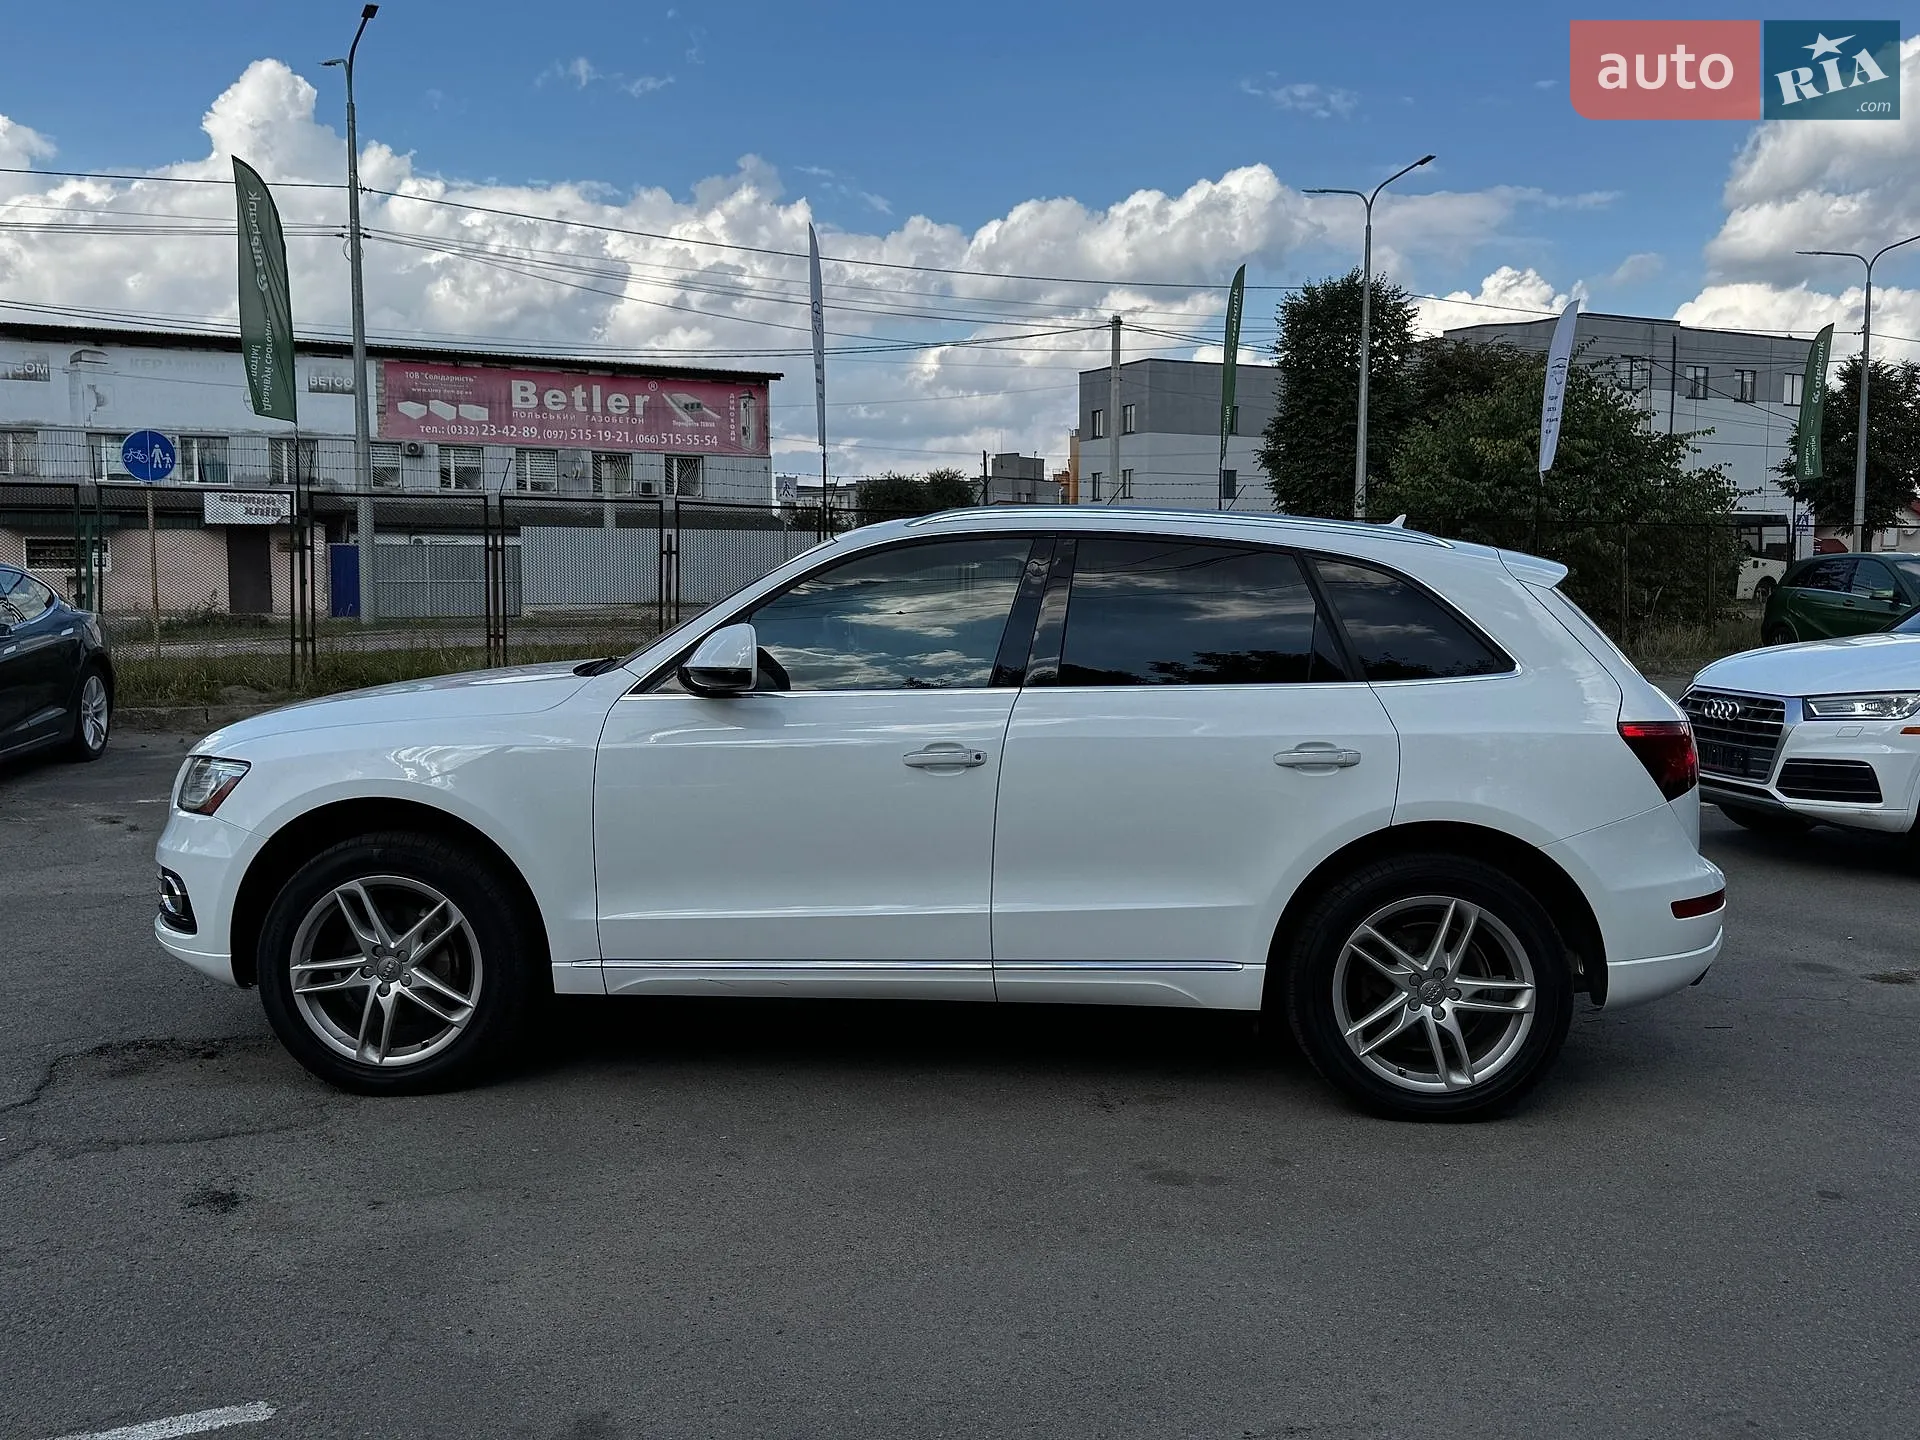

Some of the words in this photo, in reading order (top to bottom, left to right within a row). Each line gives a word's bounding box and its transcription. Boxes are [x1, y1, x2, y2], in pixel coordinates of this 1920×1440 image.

[511, 379, 650, 416] Betler
[446, 424, 480, 437] (0332)
[543, 429, 568, 441] (097)
[635, 434, 659, 445] (066)
[660, 432, 719, 446] 515-55-54
